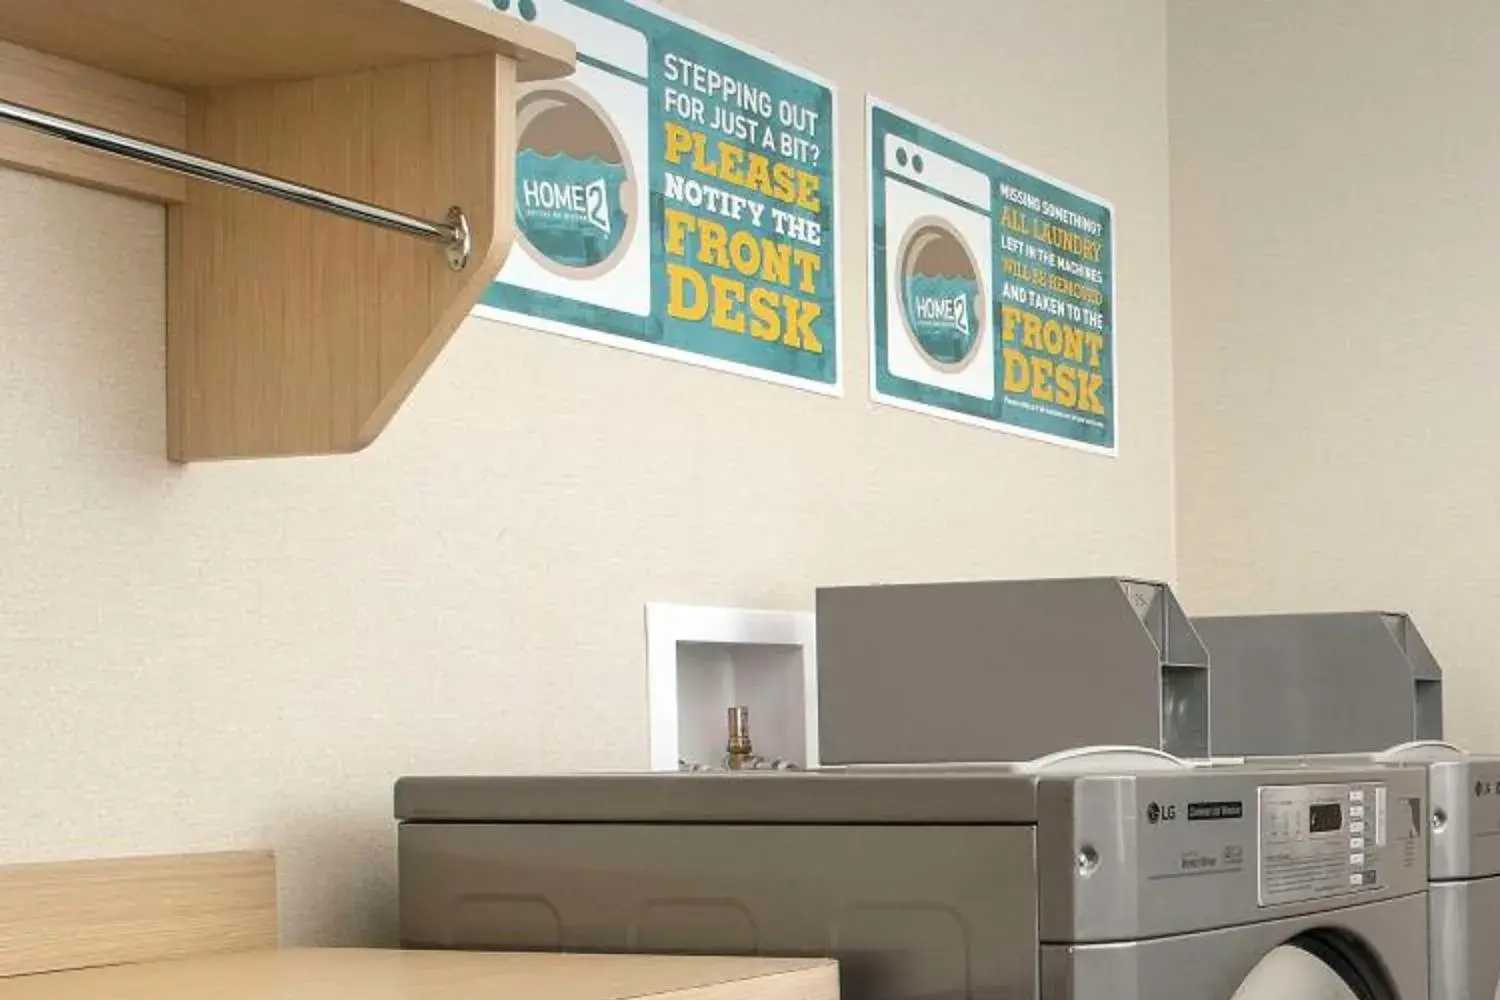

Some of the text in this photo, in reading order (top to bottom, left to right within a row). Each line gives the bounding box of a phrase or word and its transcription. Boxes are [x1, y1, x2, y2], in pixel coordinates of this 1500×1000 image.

[664, 53, 818, 136] STEPPING OUT
[664, 88, 819, 167] FOR JUST A BIT?
[664, 121, 821, 213] PLEASE
[664, 172, 821, 246] NOTIFY THE
[1001, 235, 1025, 255] LEFT
[665, 208, 821, 294] FRONT
[667, 262, 823, 353] DESK
[1001, 305, 1104, 369] FRONT
[1002, 281, 1104, 330] AND TAKEN TO THE
[1002, 347, 1105, 415] DESK
[1161, 804, 1176, 821] LG
